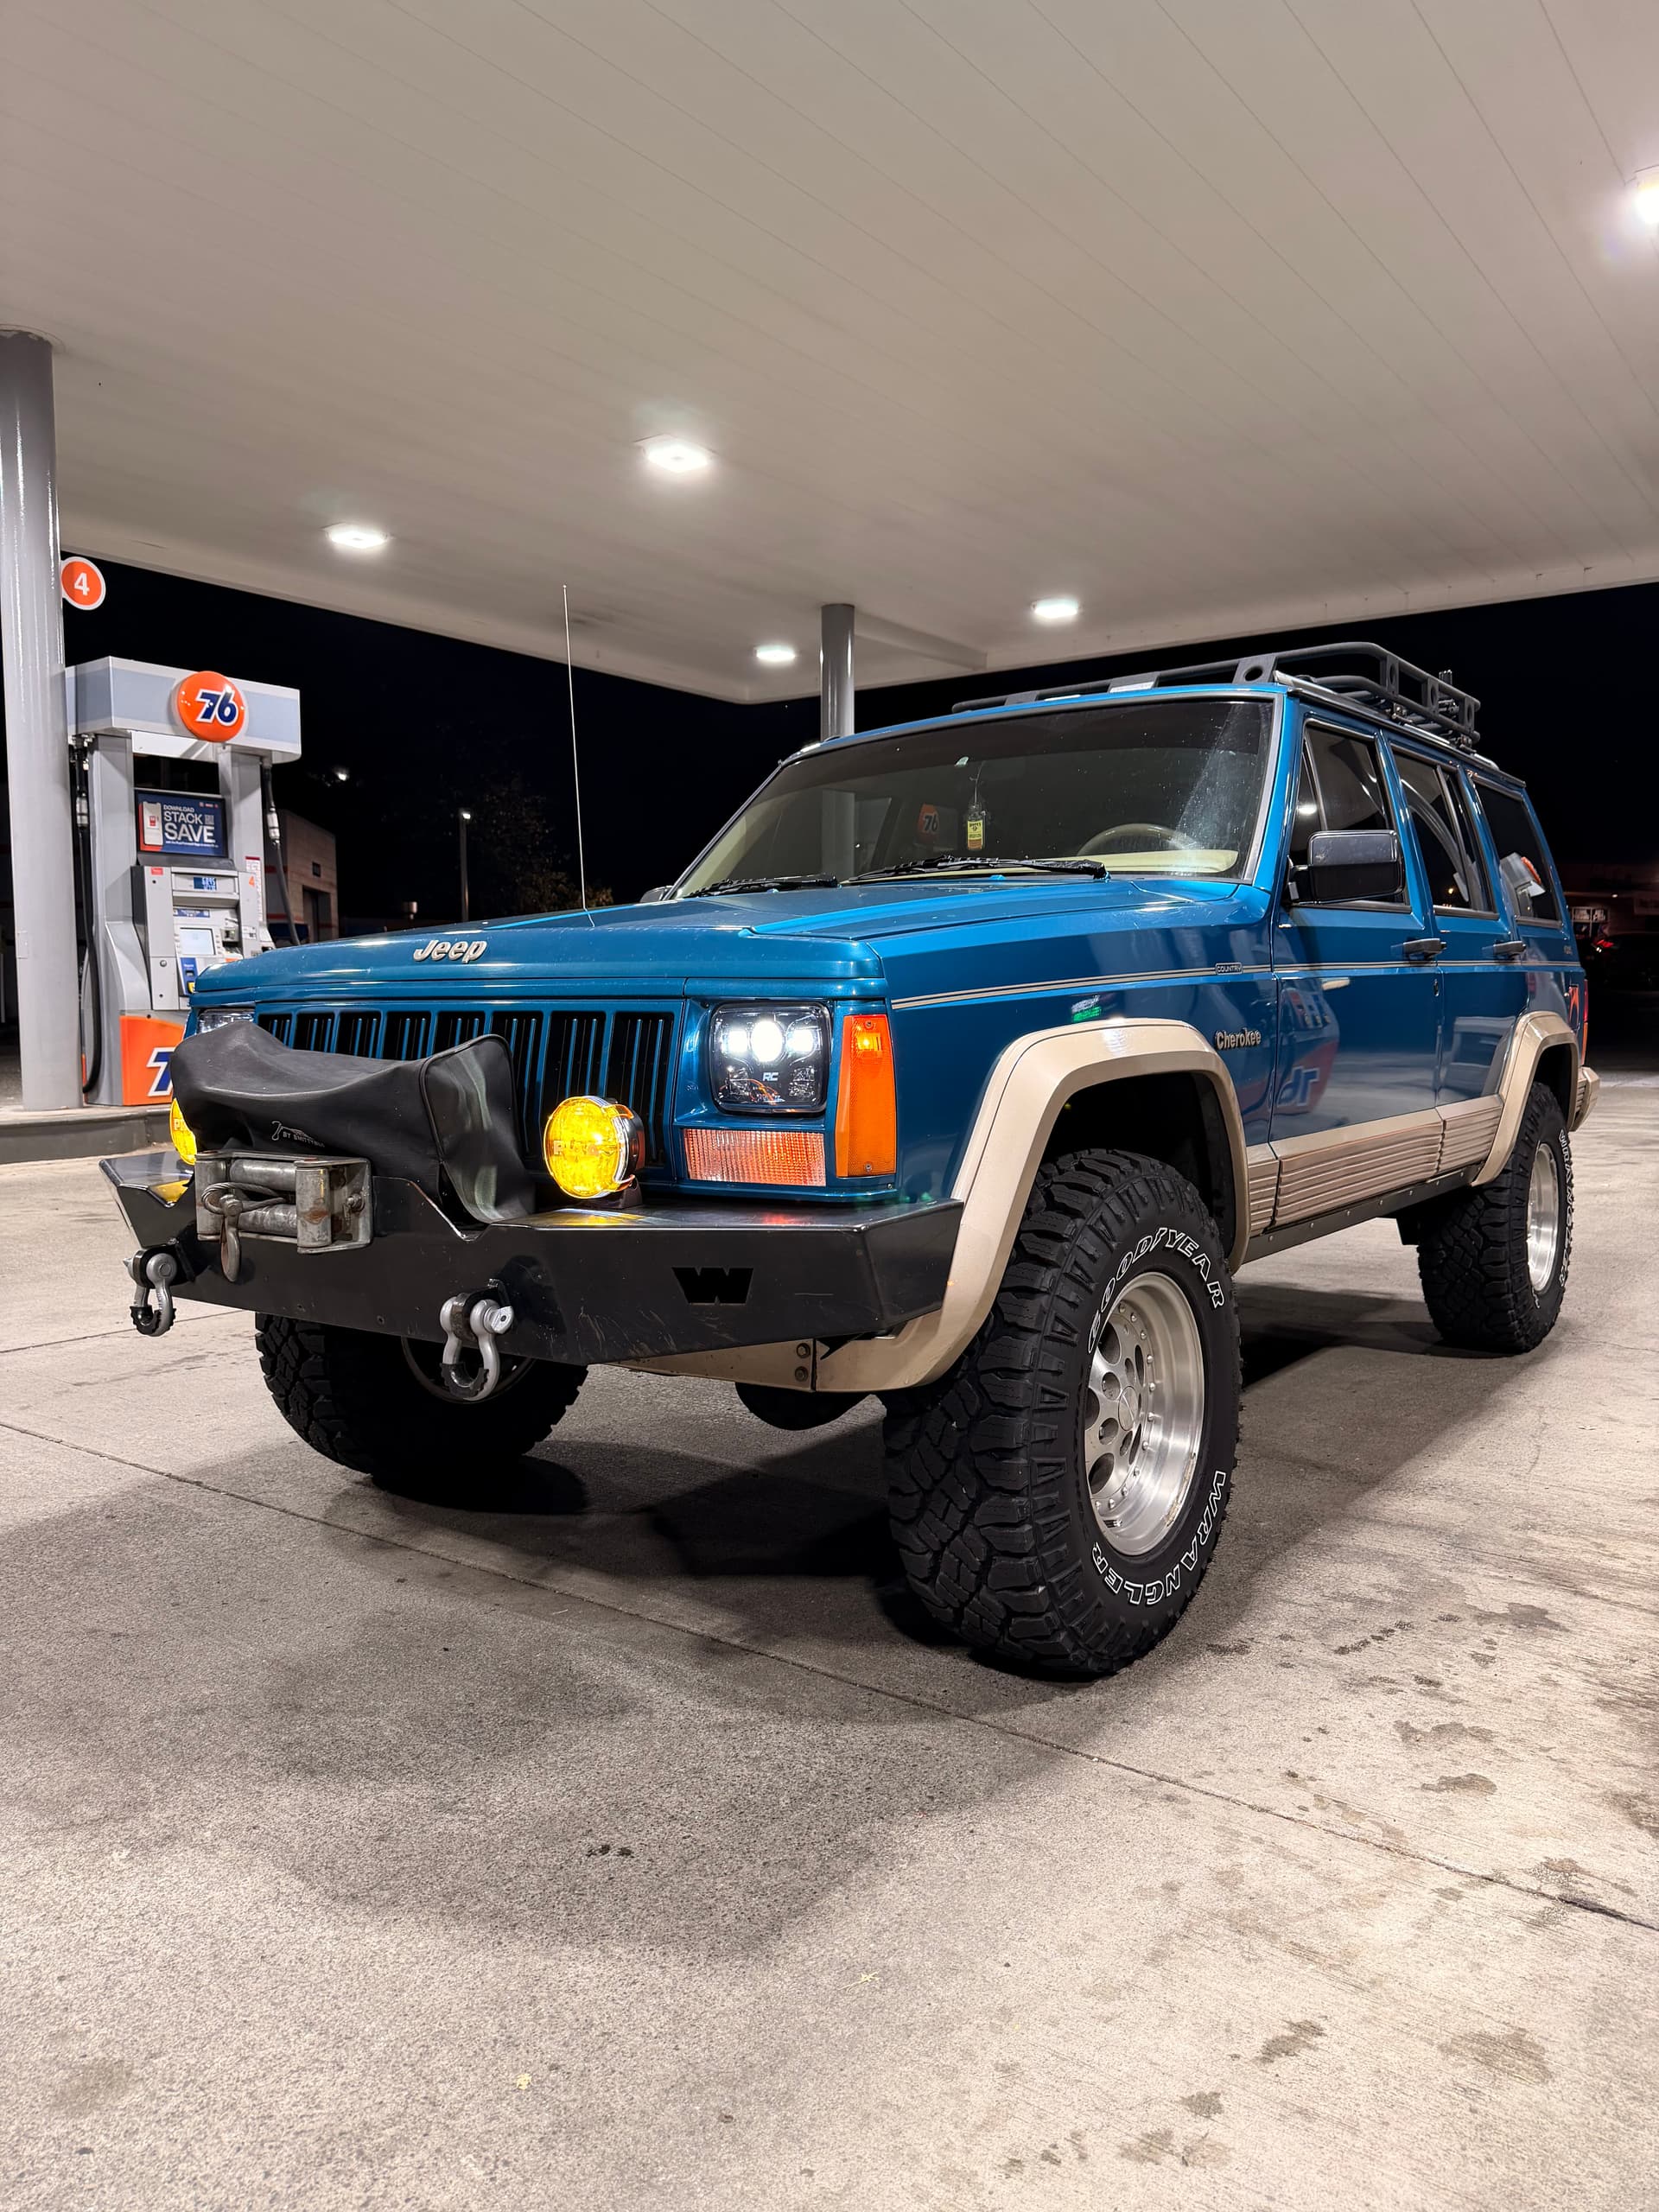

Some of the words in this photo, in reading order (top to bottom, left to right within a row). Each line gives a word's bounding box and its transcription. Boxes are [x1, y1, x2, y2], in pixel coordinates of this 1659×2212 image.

[74, 572, 90, 595] 4
[195, 689, 238, 727] 76
[163, 804, 195, 813] DOWNLOAD
[164, 810, 203, 824] STACK
[164, 823, 215, 843] SAVE
[413, 940, 487, 963] Jeep
[1216, 1028, 1261, 1050] Cherokee
[762, 1071, 779, 1081] RC
[1089, 1228, 1224, 1354] GOODYEAR
[1092, 1471, 1226, 1605] WRANGLER
